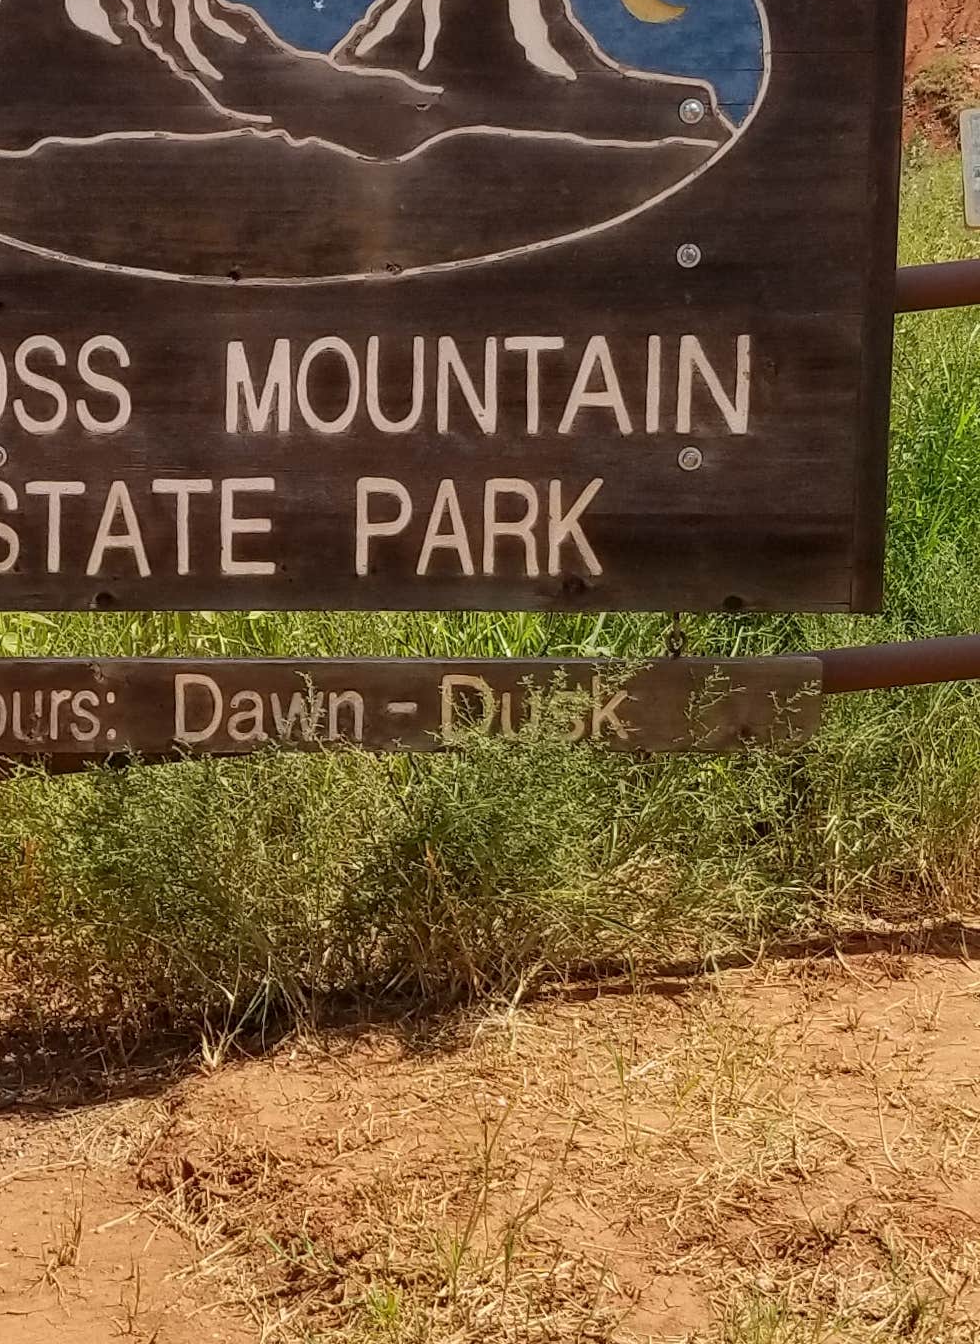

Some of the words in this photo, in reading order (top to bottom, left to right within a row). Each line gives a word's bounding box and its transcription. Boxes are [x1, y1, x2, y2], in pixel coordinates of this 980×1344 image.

[225, 334, 752, 436] MOUNTAIN
[355, 476, 605, 578] PARK
[173, 673, 365, 742] Dawn
